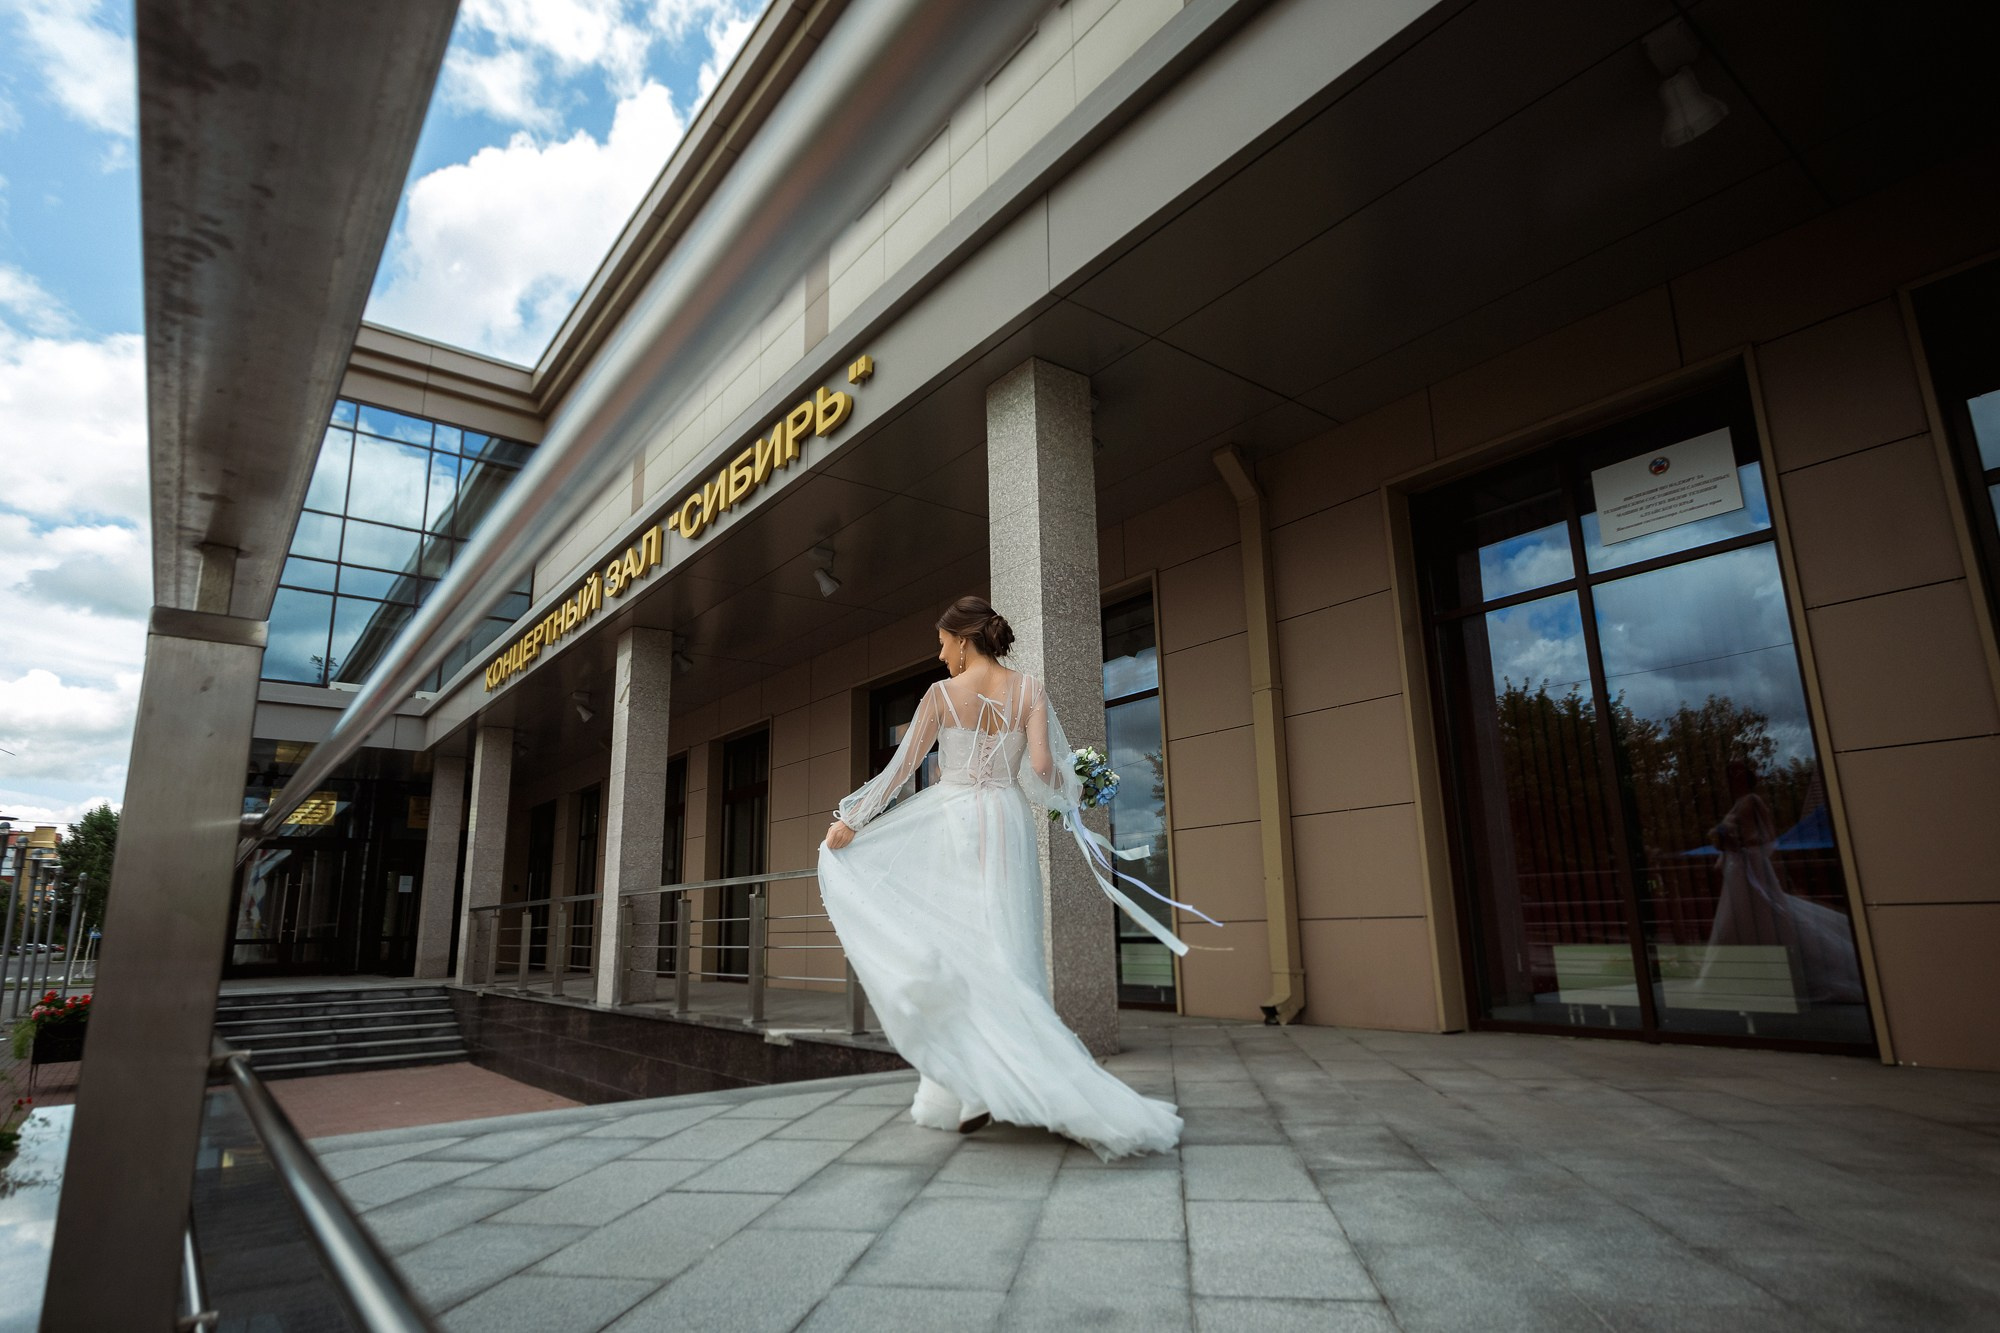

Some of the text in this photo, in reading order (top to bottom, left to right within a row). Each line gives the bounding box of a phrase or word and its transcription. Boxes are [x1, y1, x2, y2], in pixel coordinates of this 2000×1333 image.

[484, 354, 873, 692] КОНЦЕРТНЫЙ ЗАЛ "СИБИРЬ"
